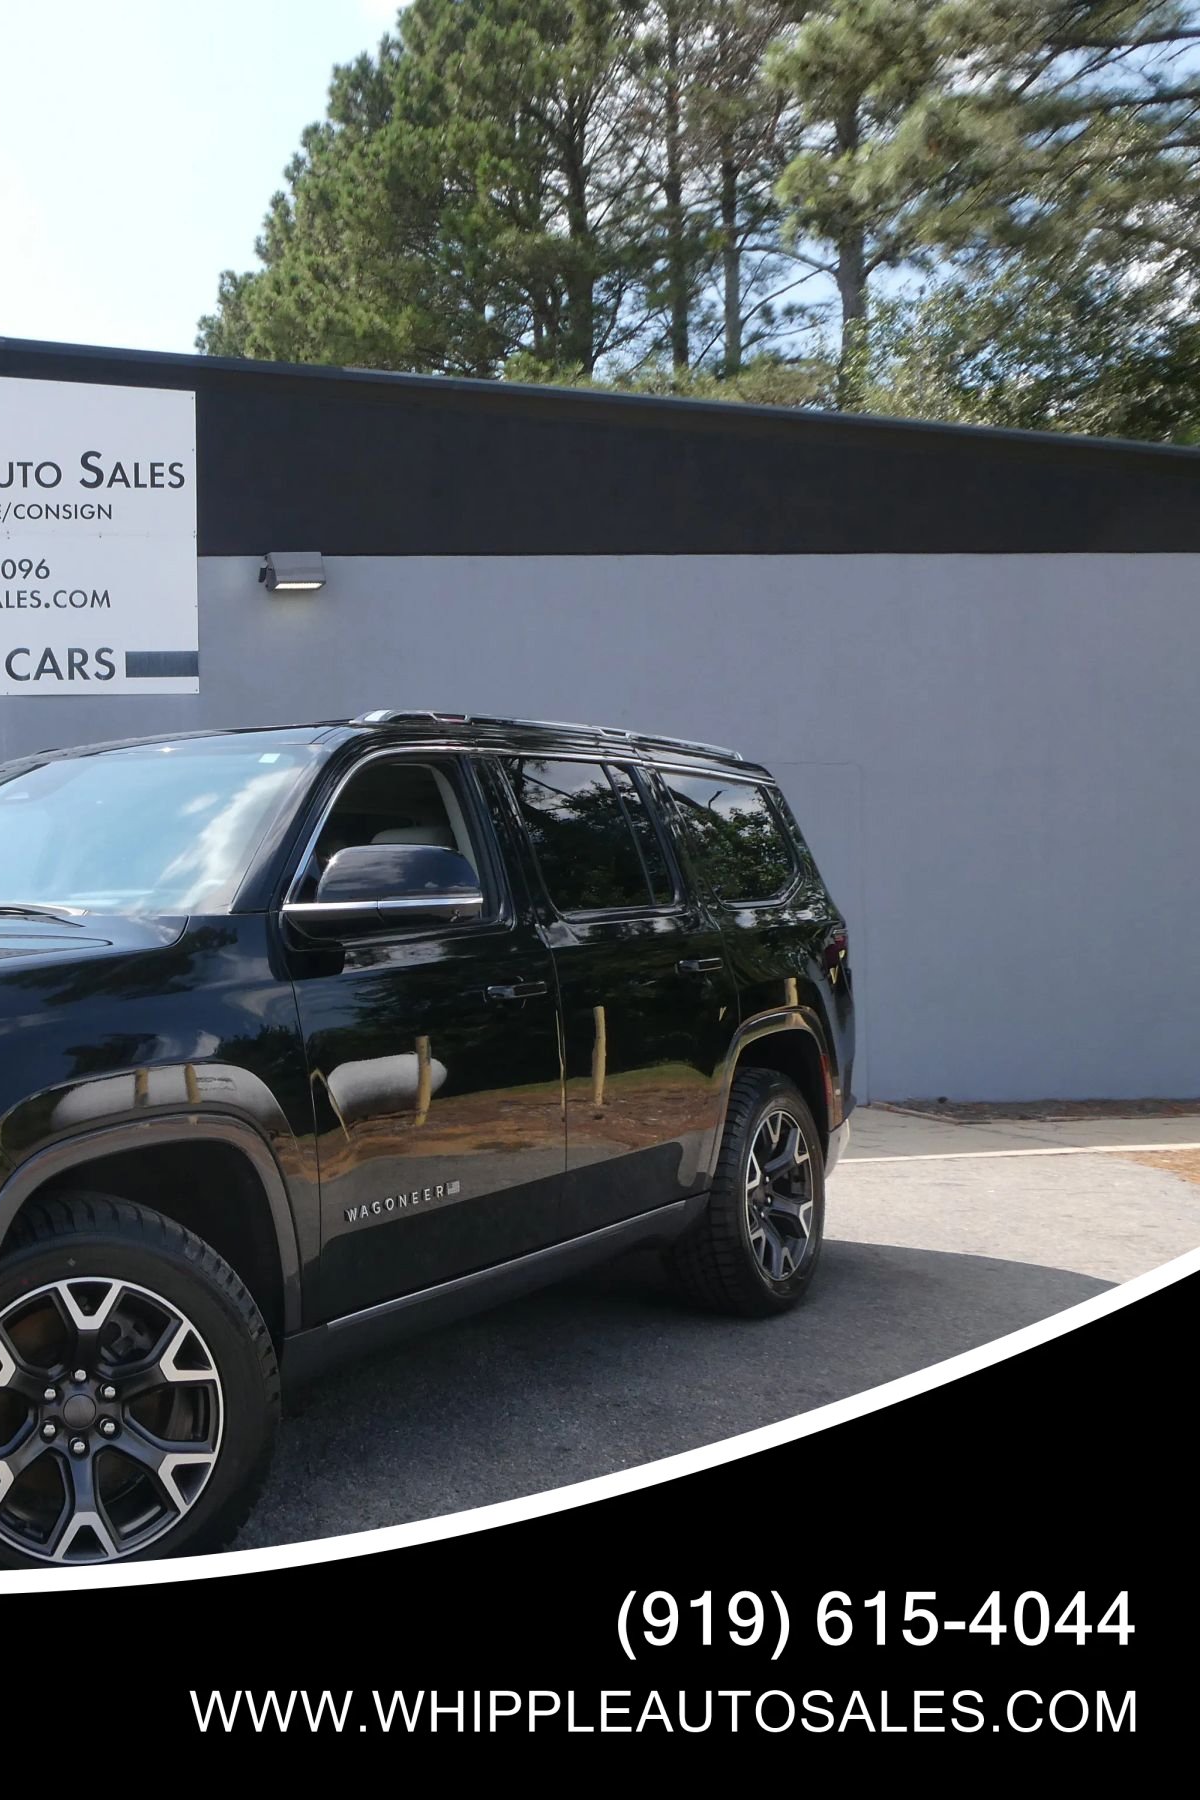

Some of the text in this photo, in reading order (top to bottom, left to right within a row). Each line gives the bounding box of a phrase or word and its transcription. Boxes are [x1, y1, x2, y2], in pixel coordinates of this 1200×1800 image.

[79, 451, 186, 489] SALES
[4, 647, 117, 682] CARS
[346, 1185, 444, 1222] WAGONEER
